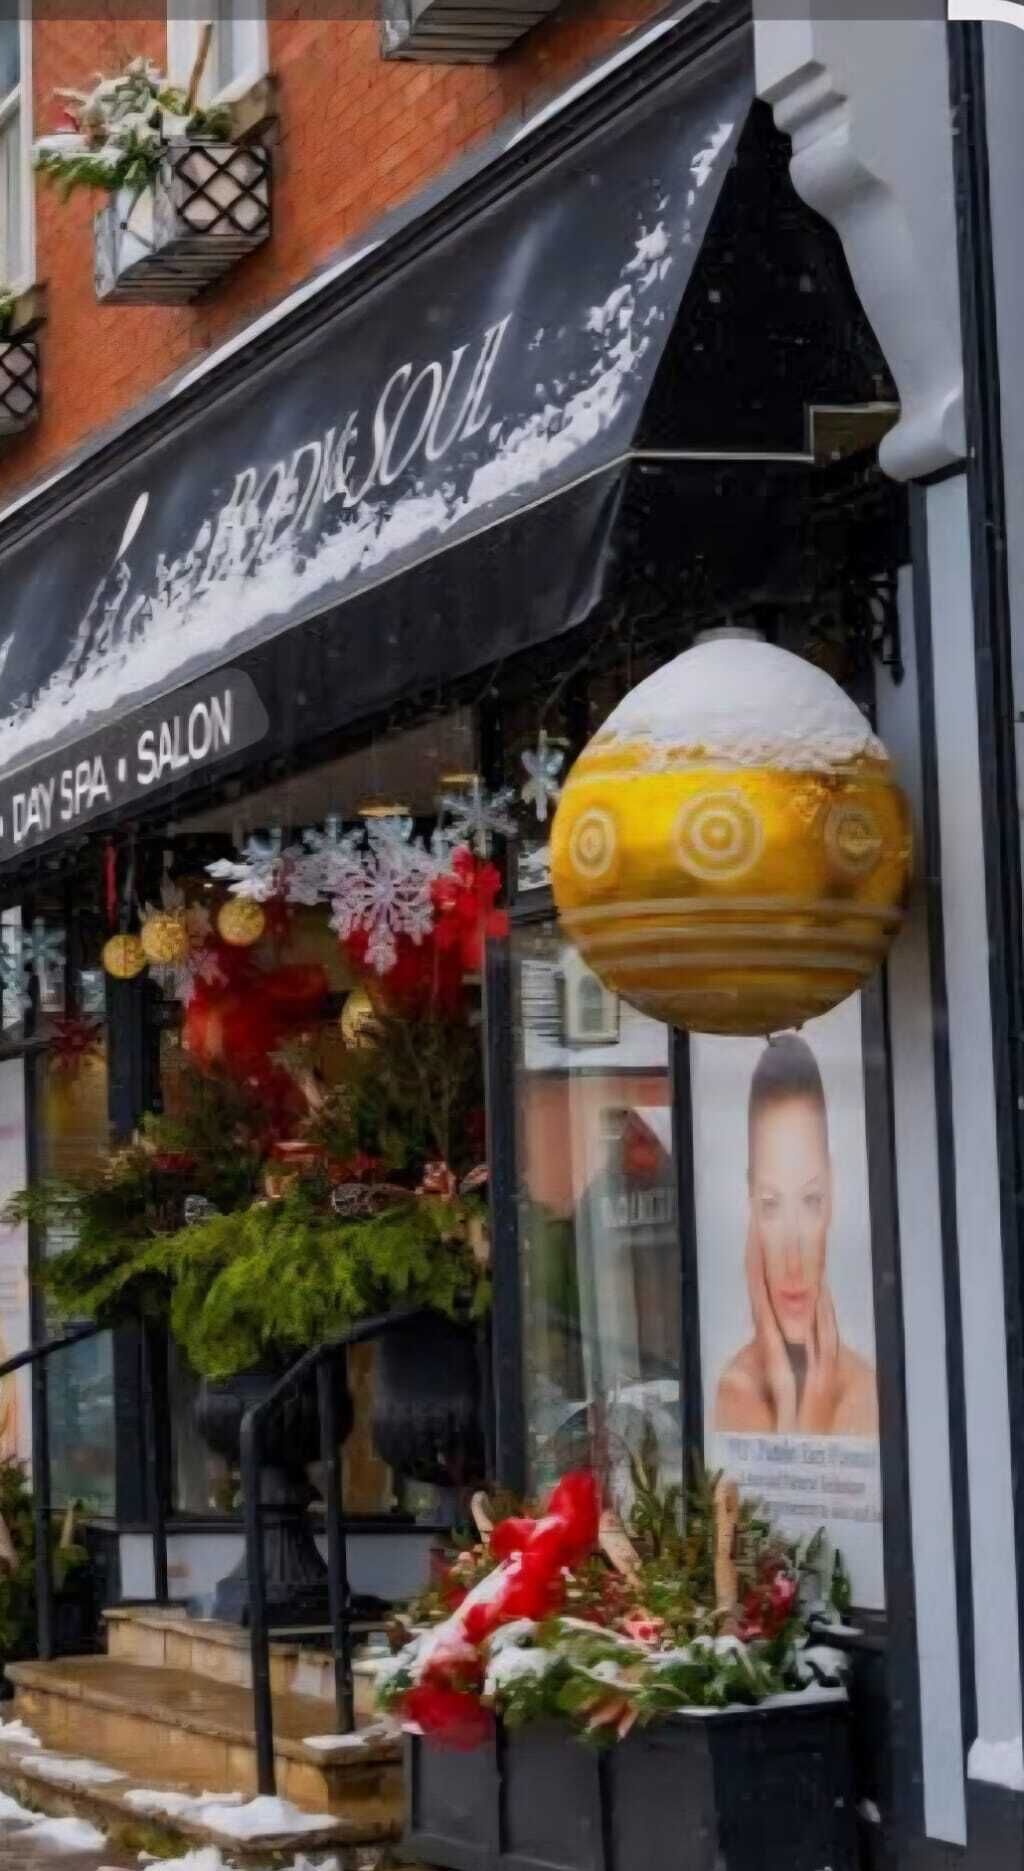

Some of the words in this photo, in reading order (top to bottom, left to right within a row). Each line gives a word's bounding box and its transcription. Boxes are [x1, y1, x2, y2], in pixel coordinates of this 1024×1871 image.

[342, 312, 512, 508] SOUL
[11, 777, 56, 844] DAY
[59, 755, 113, 821] SPA
[136, 690, 233, 786] SALON
